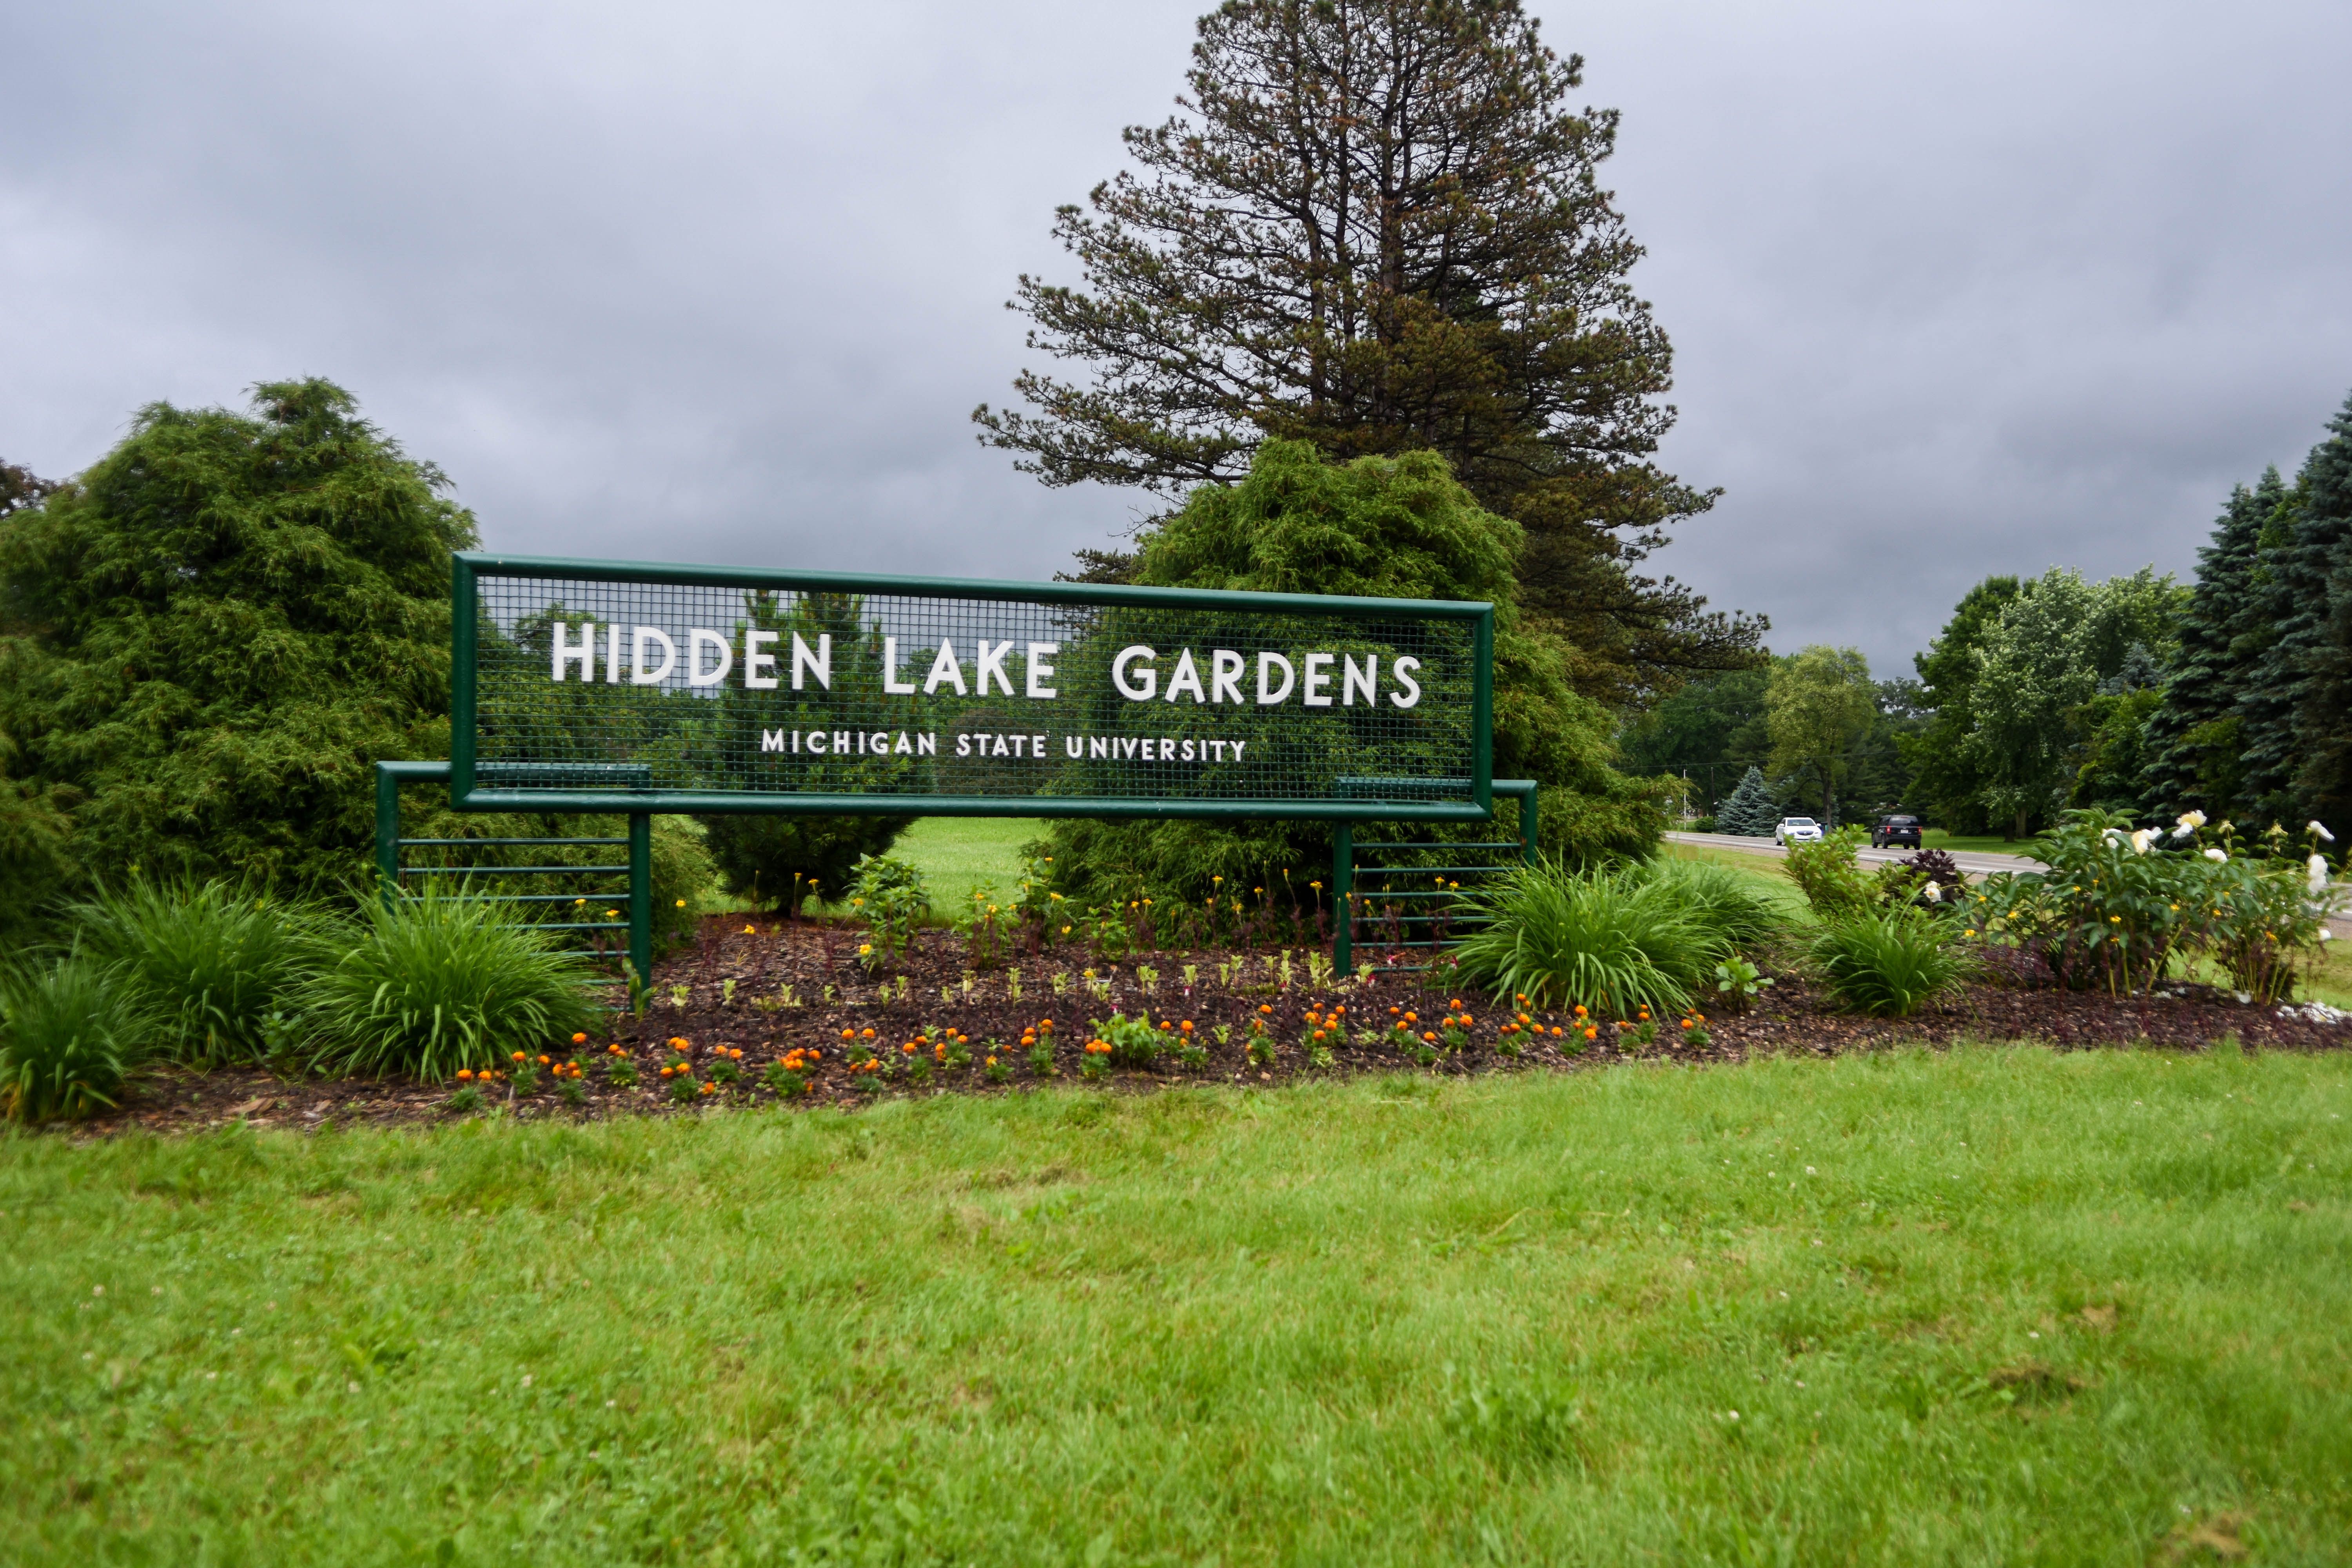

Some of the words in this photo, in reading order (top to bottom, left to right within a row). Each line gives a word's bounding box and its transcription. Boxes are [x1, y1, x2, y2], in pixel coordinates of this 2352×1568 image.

[552, 622, 831, 690] HIDDEN
[884, 637, 1058, 698] LAKE
[1112, 646, 1421, 708] GARDENS
[762, 729, 935, 755] MICHIGAN
[956, 733, 1046, 758] STATE
[1066, 736, 1246, 762] UNIVERSITY
